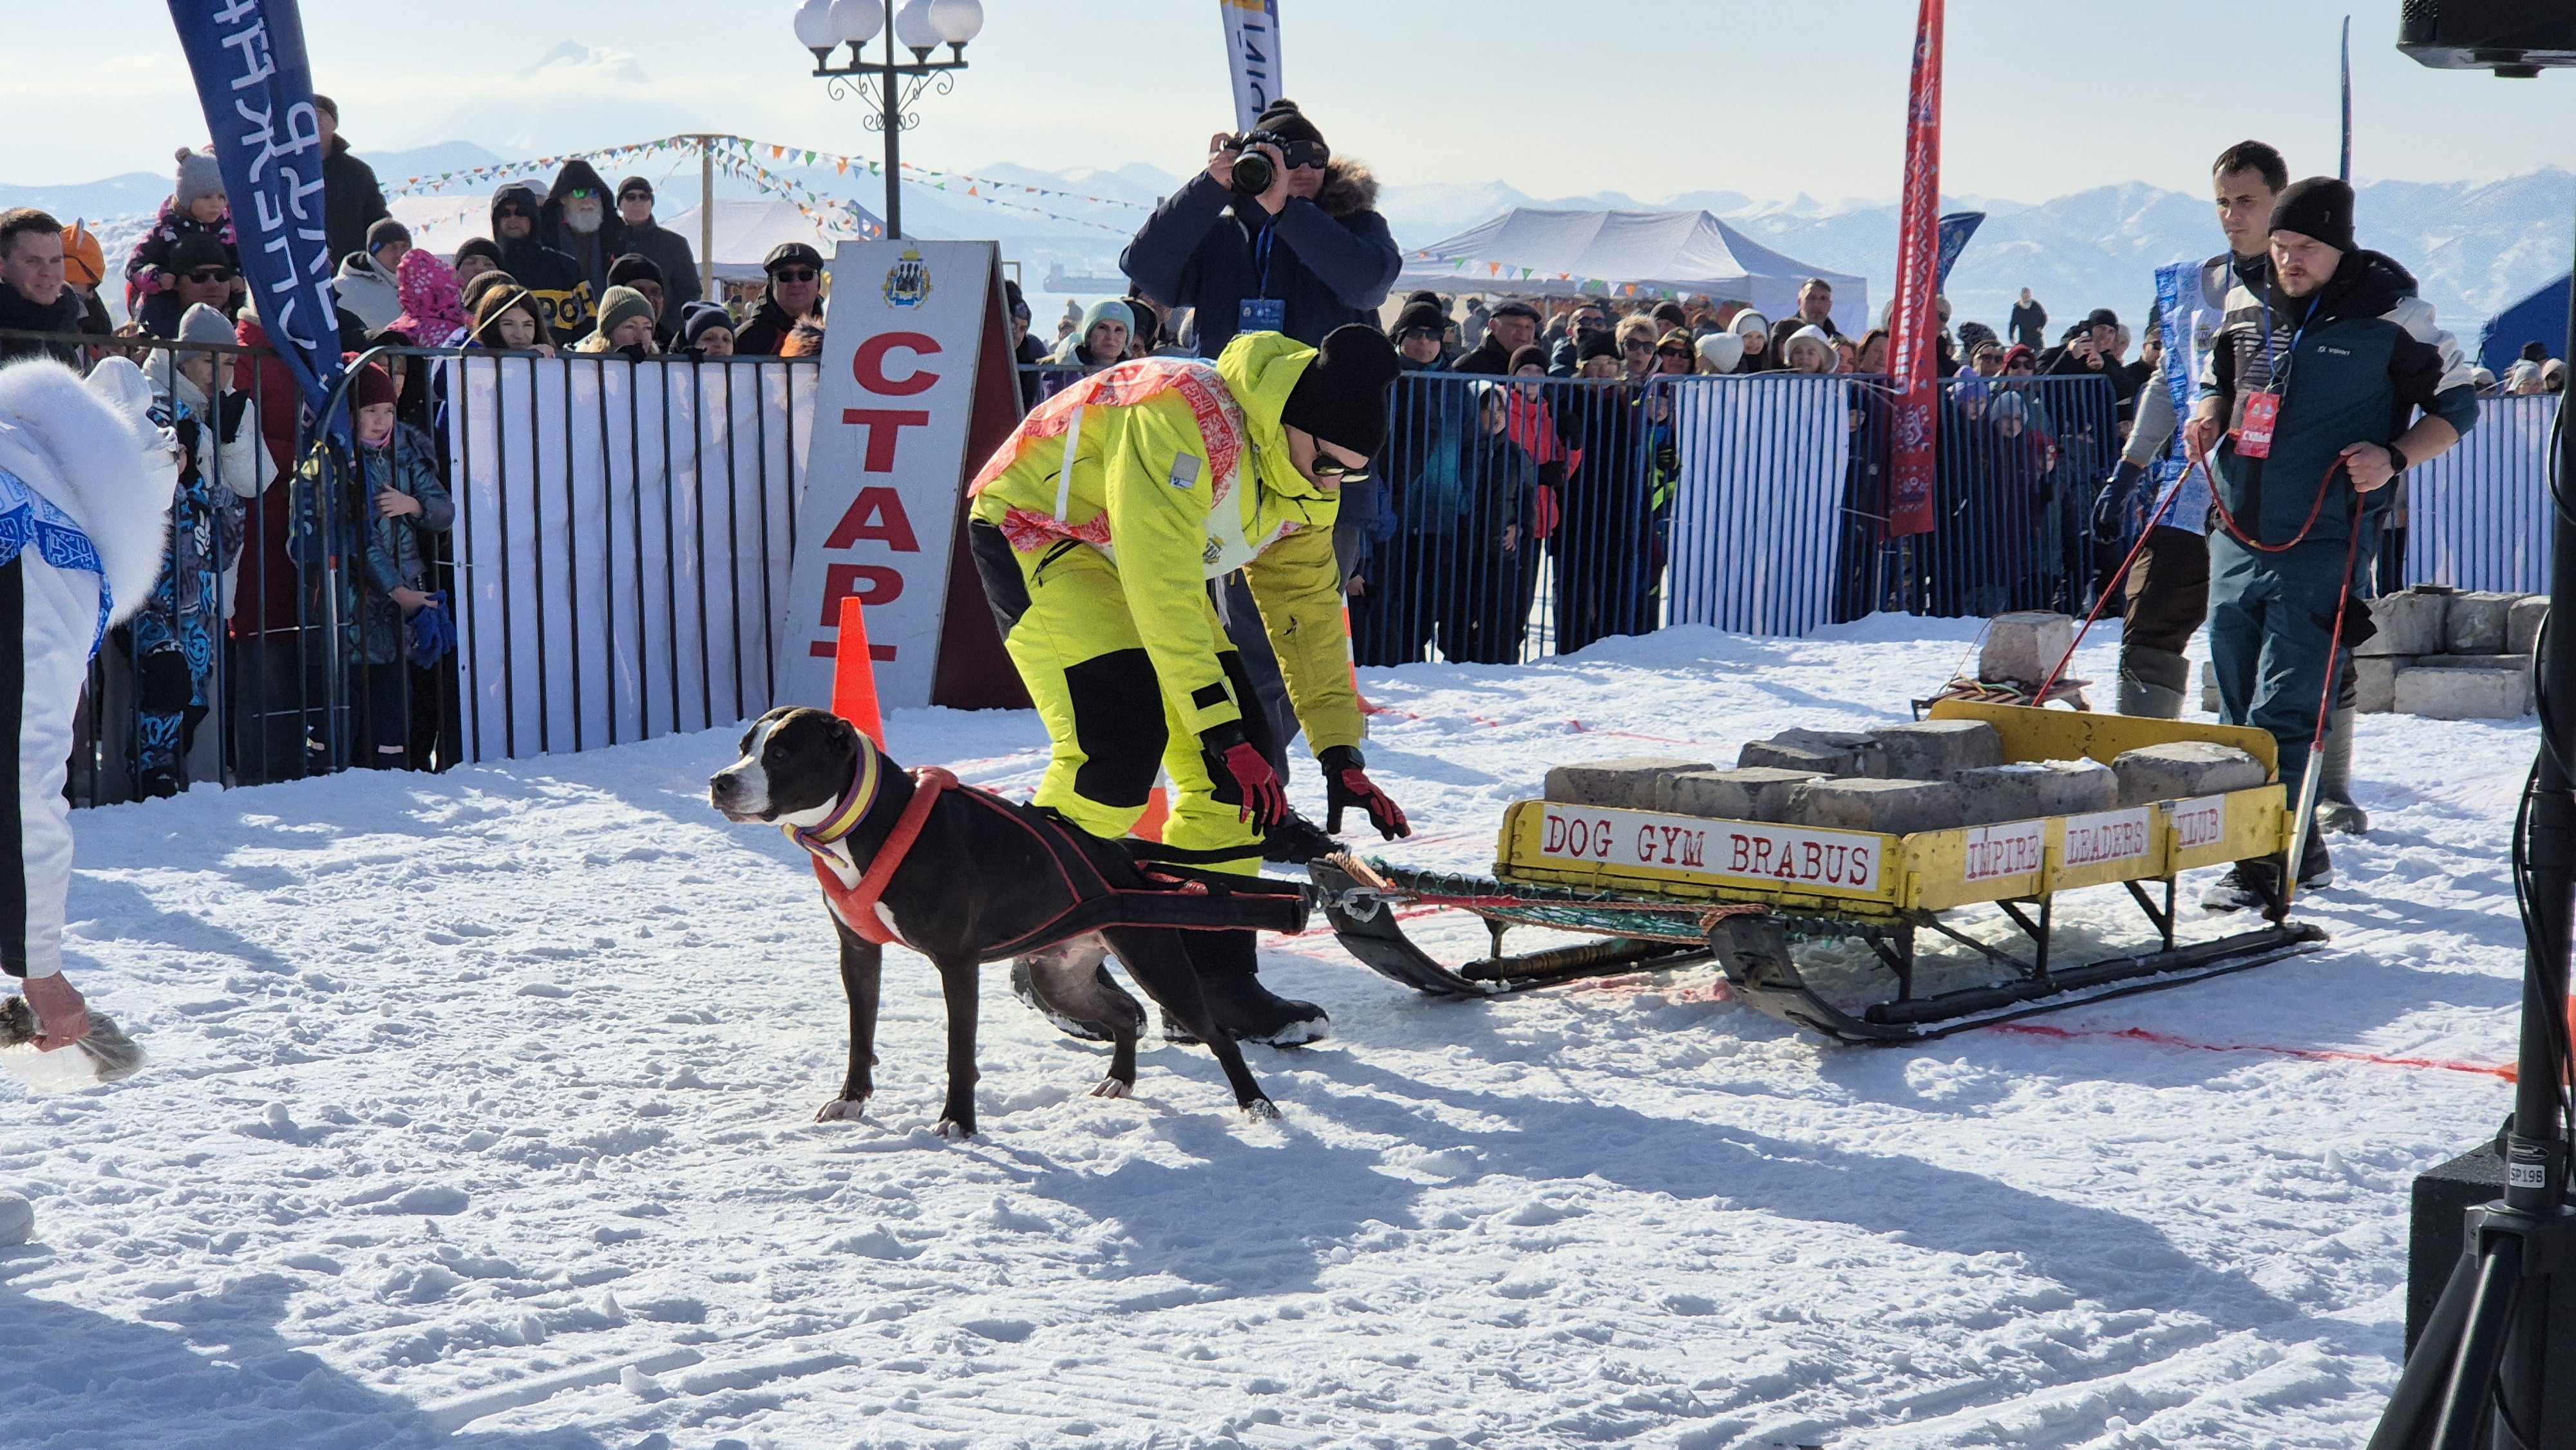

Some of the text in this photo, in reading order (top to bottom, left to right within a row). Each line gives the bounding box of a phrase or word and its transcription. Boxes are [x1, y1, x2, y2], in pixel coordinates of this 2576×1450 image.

[1544, 814, 1869, 885] DOG GYM BRABUS
[2067, 820, 2143, 864] LEADERS
